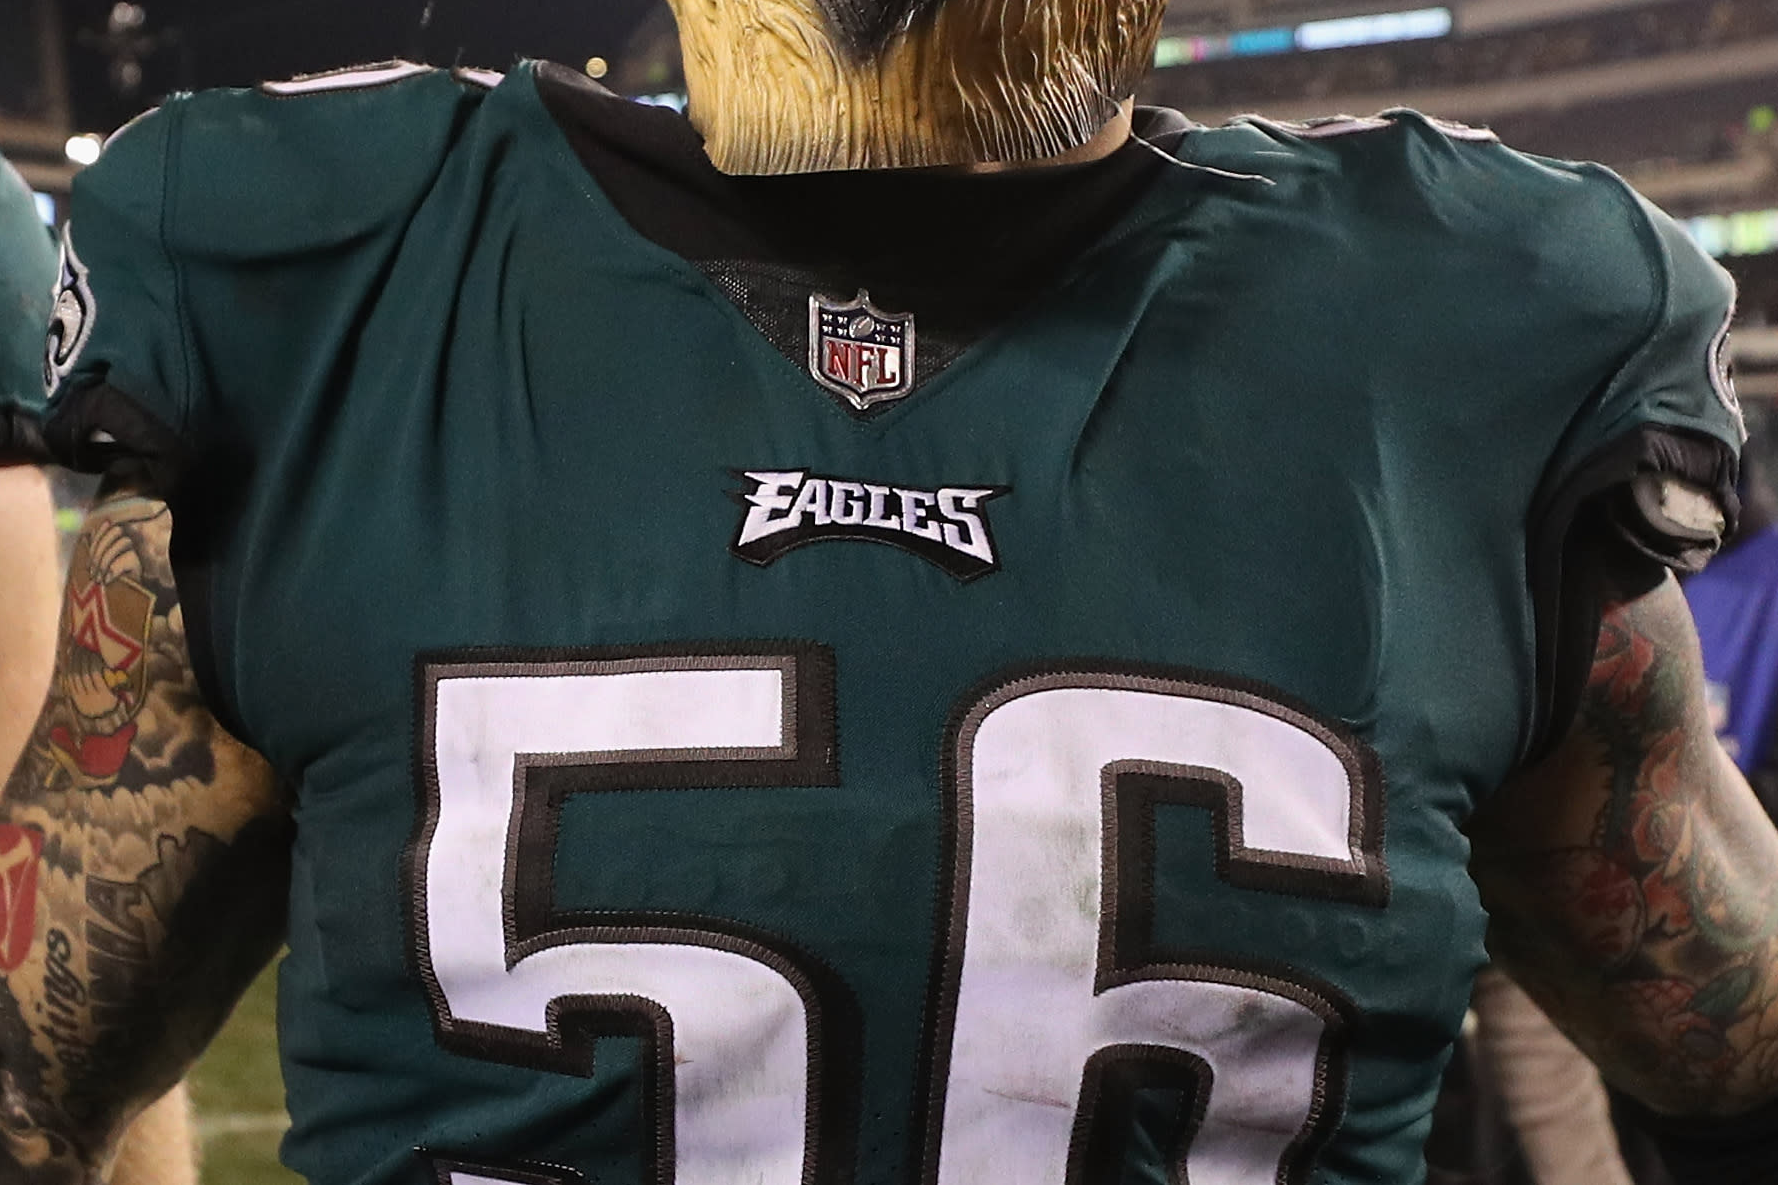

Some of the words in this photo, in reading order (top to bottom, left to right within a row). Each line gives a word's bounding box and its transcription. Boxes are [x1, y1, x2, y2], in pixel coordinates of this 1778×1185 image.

[825, 340, 897, 384] NFL
[738, 471, 994, 564] EAGLES
[417, 657, 1367, 1185] 56
